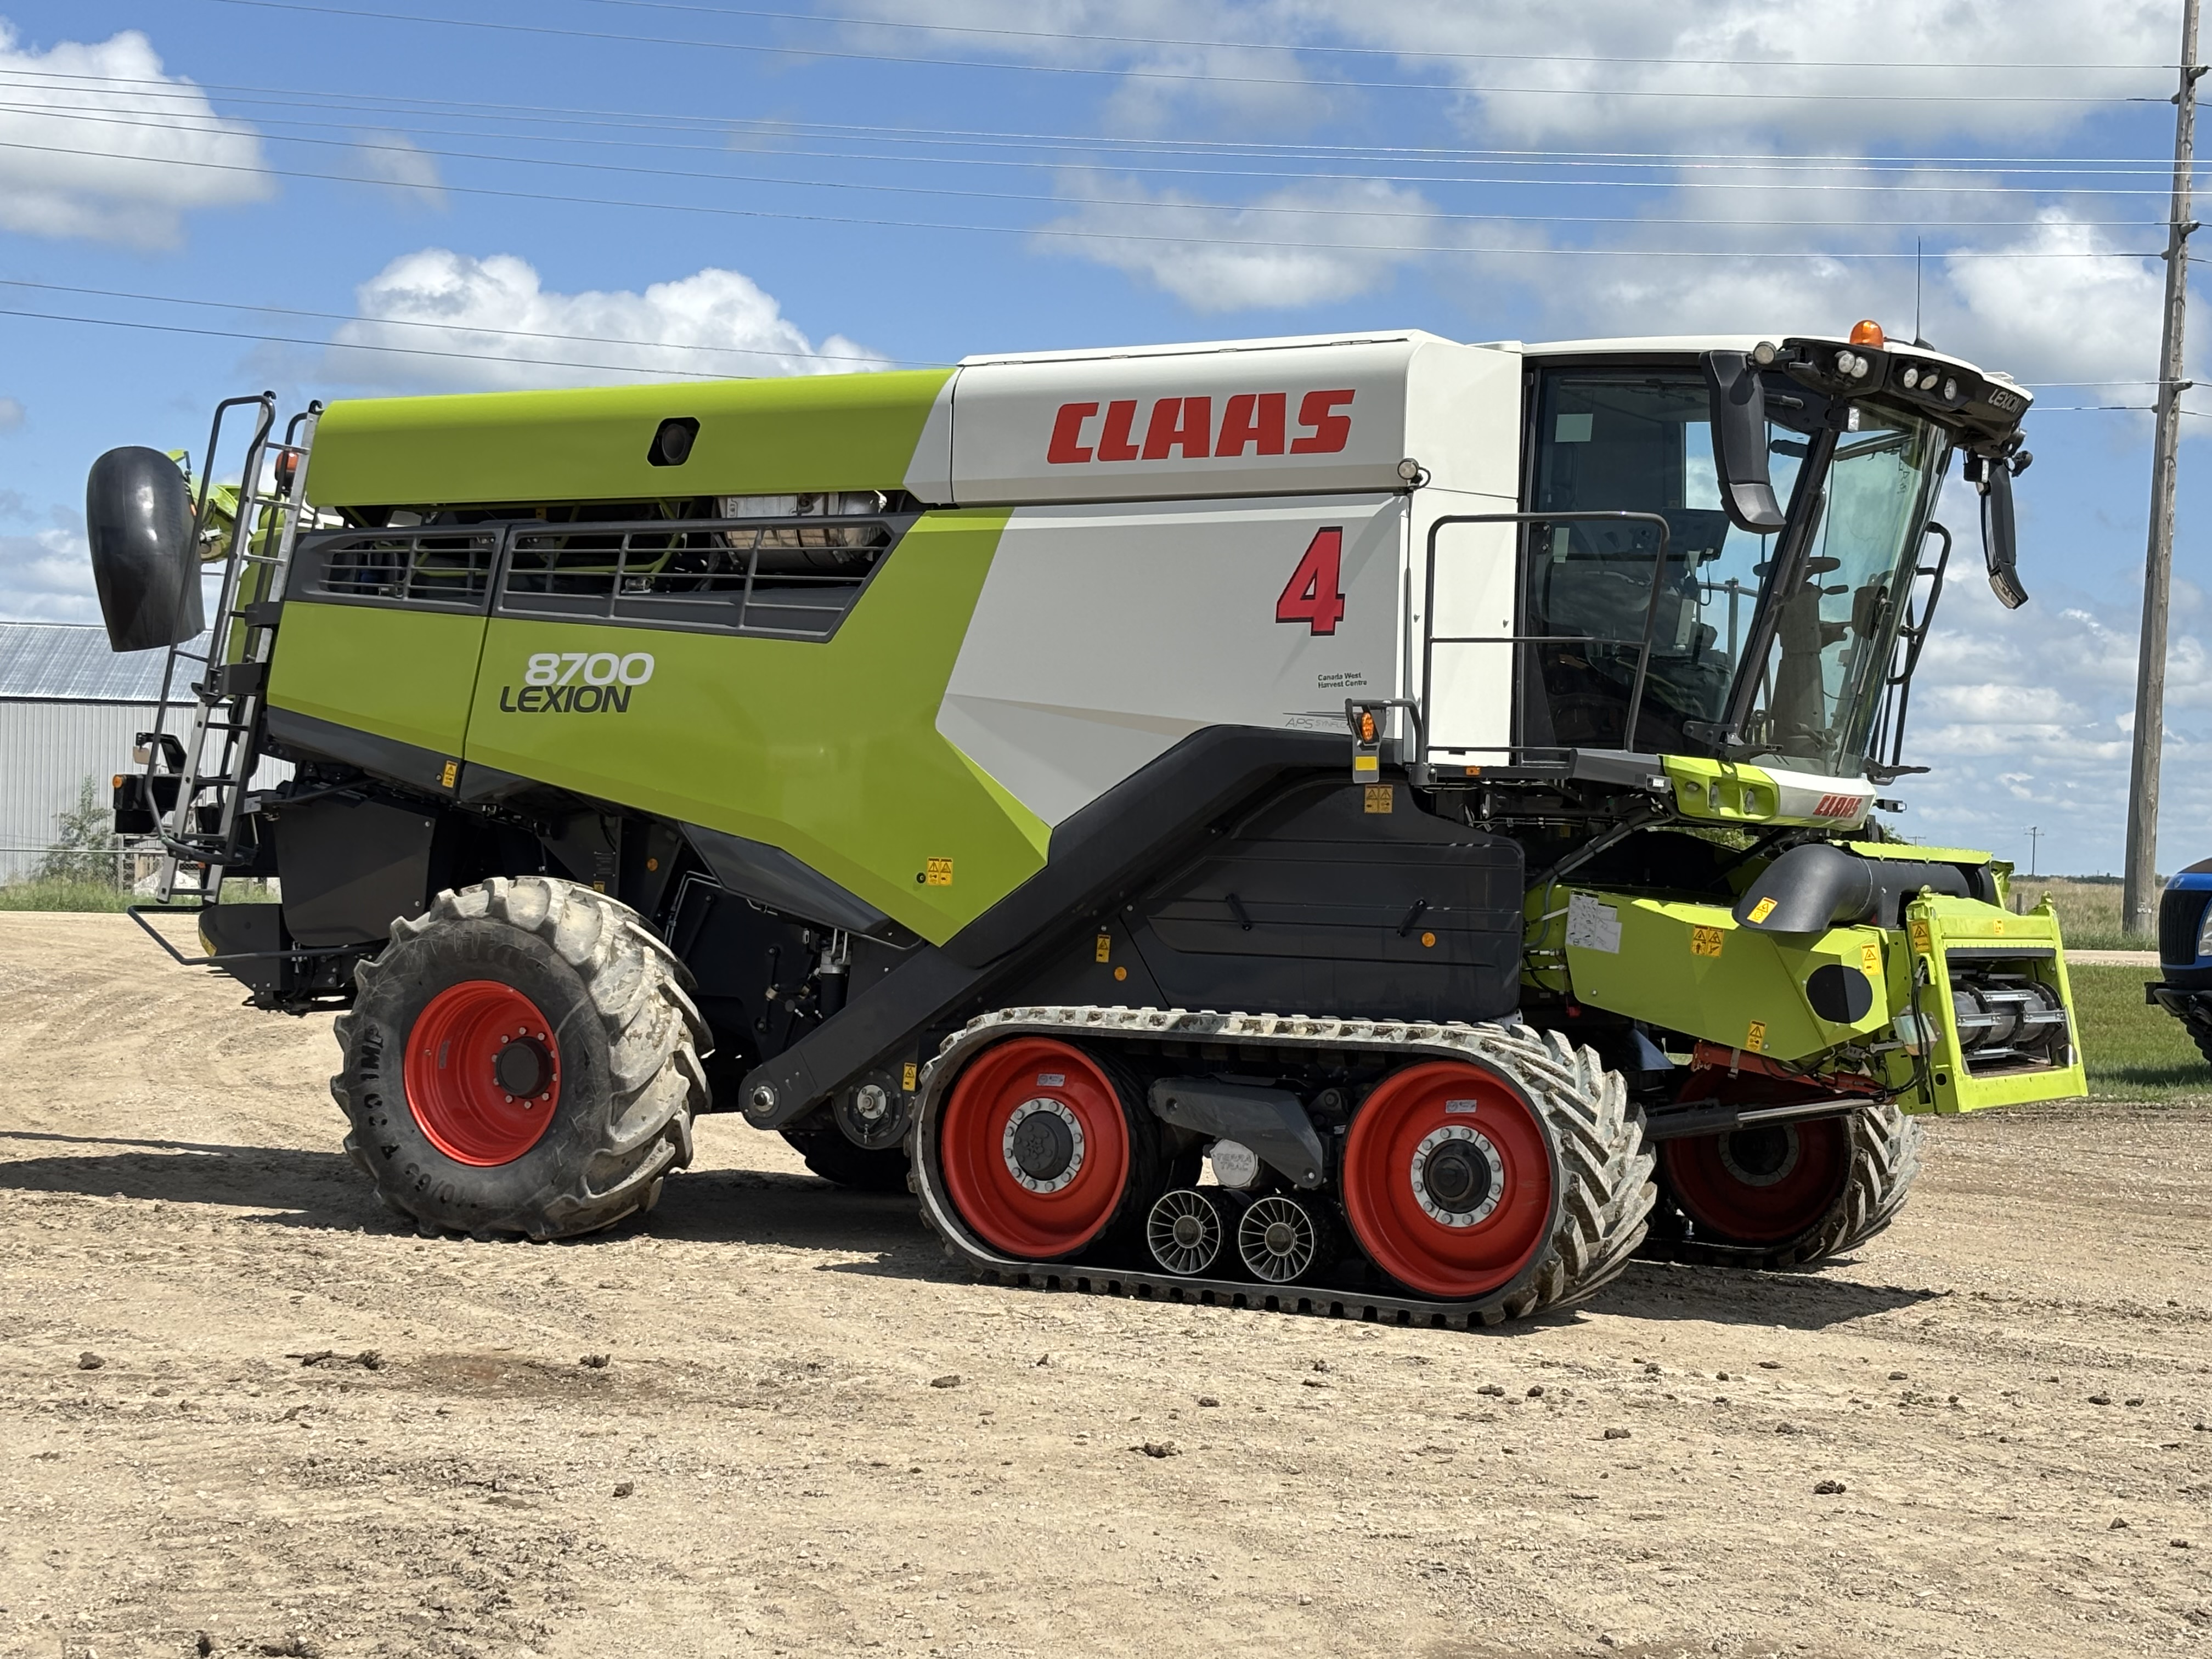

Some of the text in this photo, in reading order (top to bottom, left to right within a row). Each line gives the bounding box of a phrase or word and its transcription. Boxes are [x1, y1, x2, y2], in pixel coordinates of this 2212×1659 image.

[1047, 389, 1356, 464] CLAAS
[1276, 526, 1346, 636] 4
[524, 652, 655, 686] 8700
[1318, 673, 1343, 681] Canada
[500, 686, 633, 713] LEXION
[1285, 718, 1314, 729] APS
[1812, 794, 1863, 819] CLAAS
[1216, 1153, 1252, 1163] TERRA
[1220, 1161, 1249, 1171] TRAC
